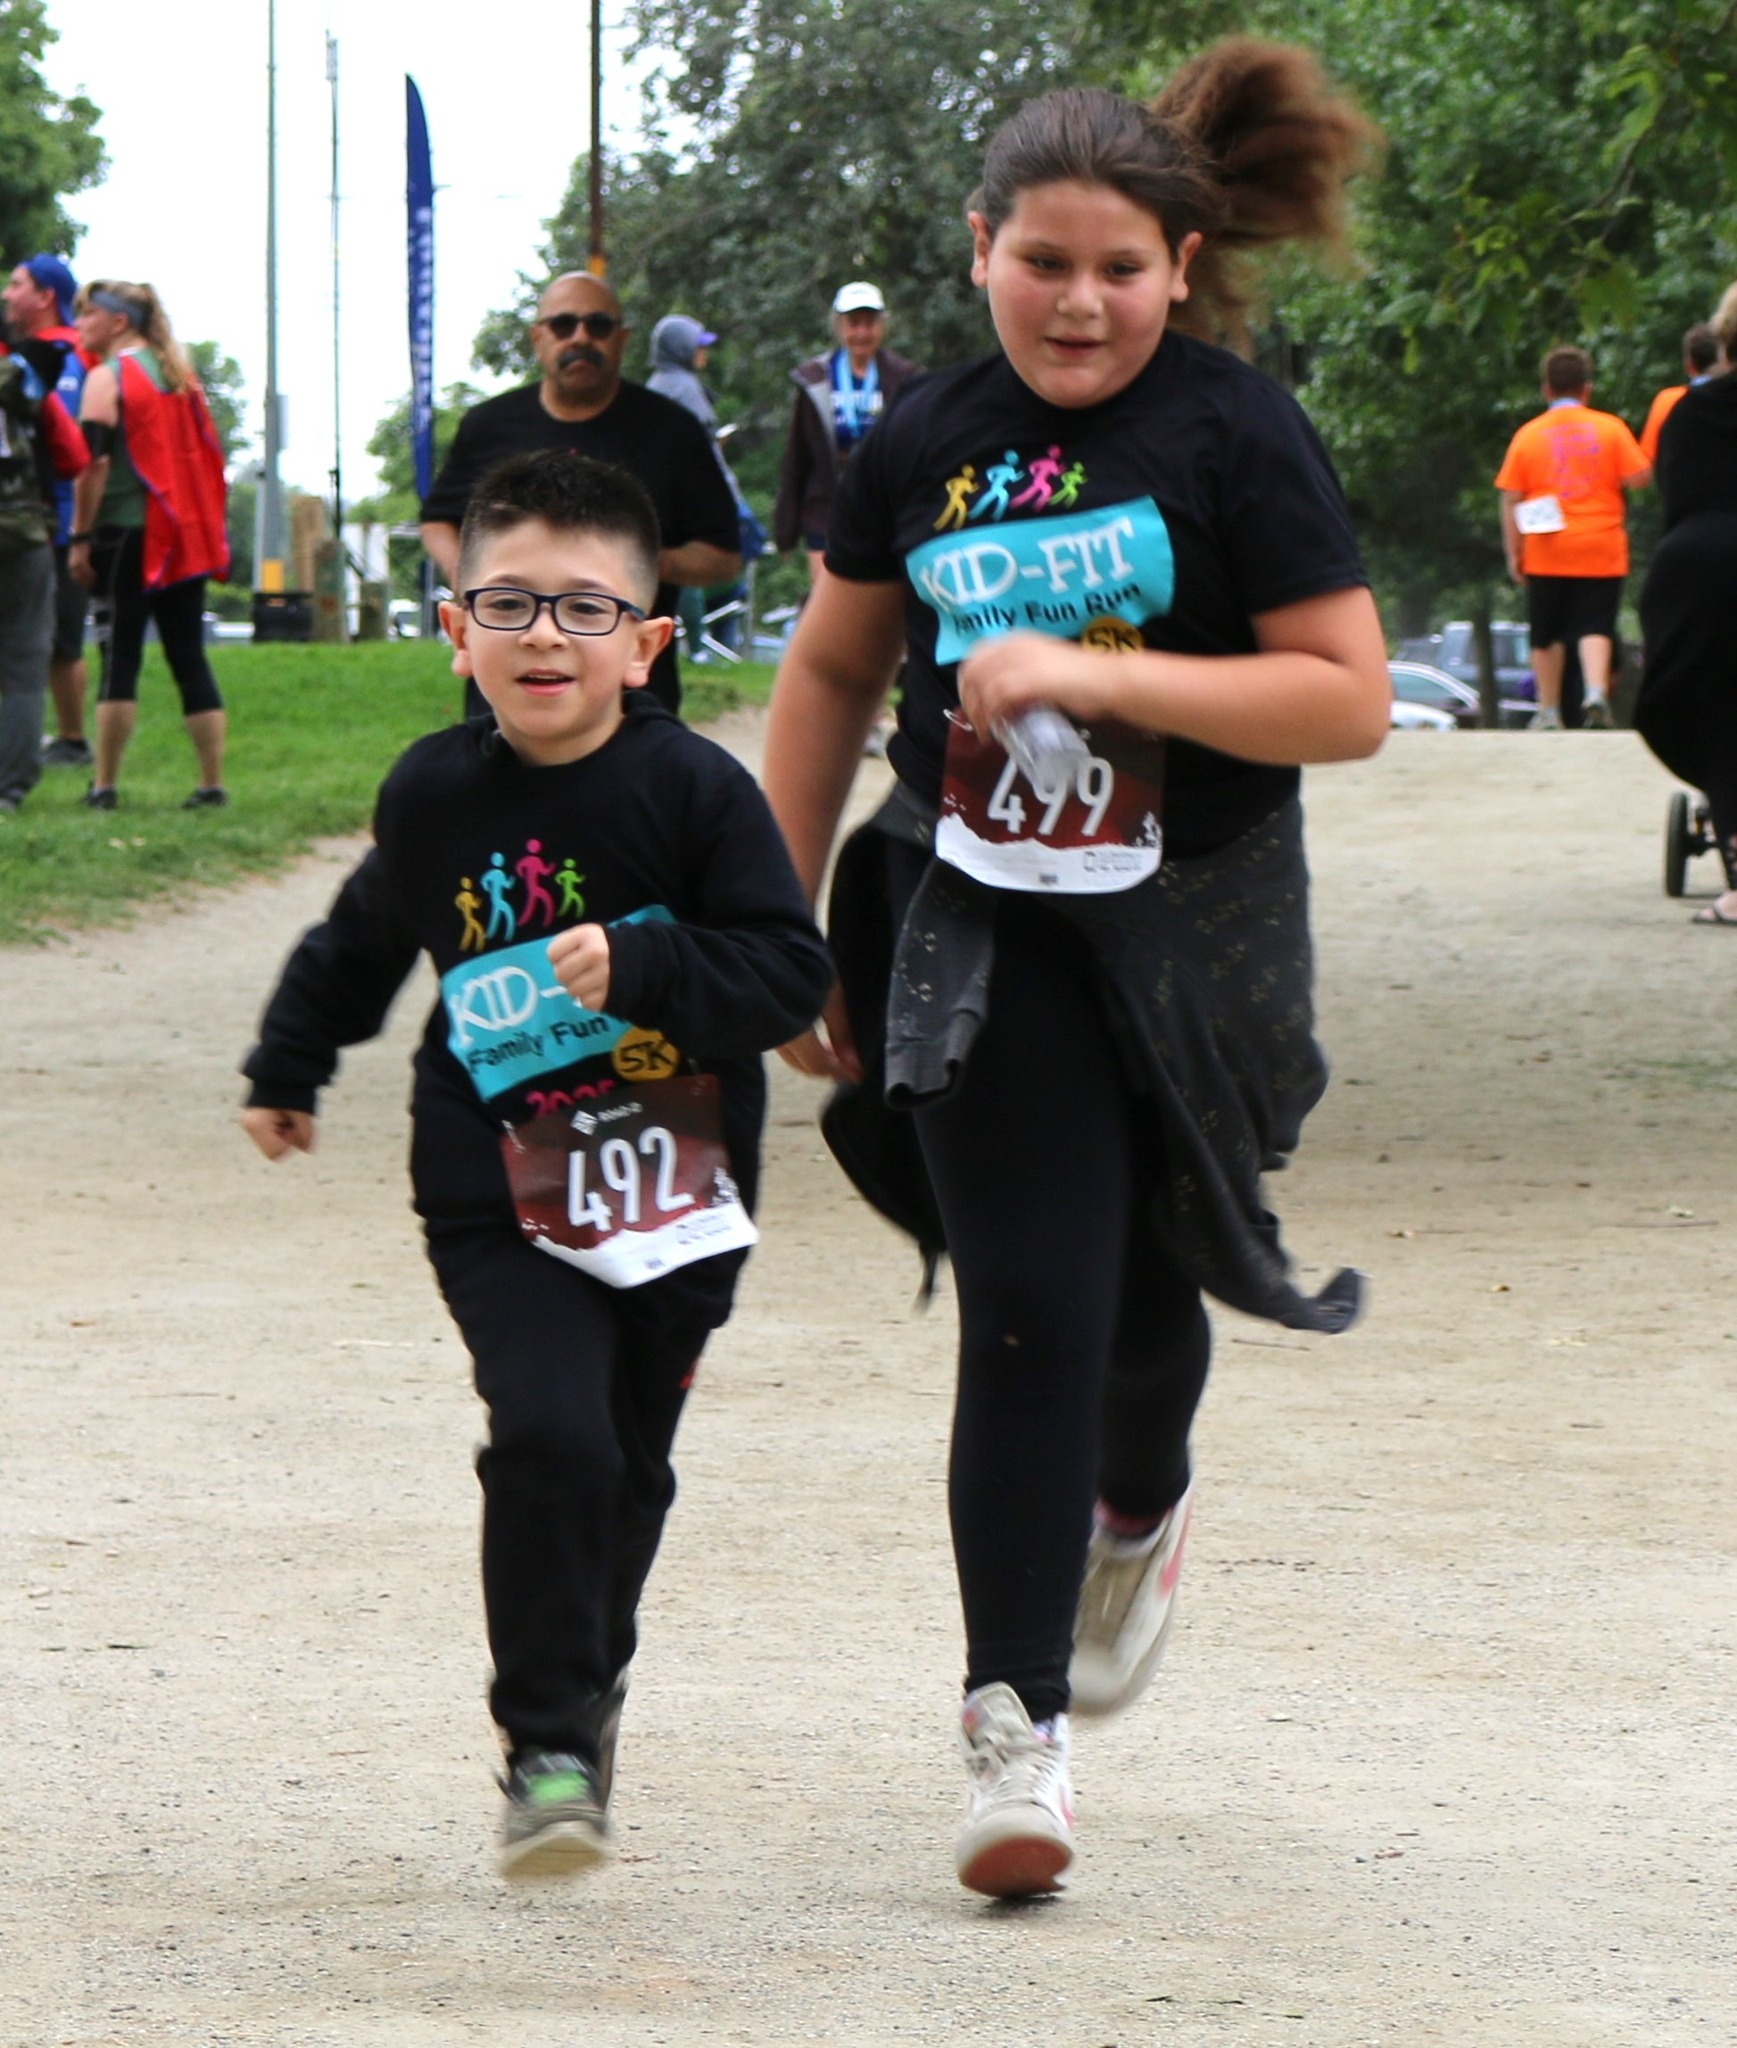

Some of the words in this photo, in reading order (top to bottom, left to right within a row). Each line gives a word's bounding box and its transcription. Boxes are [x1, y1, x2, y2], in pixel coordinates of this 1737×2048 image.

[919, 516, 1135, 612] KID-FIT
[1024, 600, 1079, 624] Fun
[1084, 581, 1142, 617] Run
[986, 756, 1115, 838] 499
[448, 965, 583, 1048] KID-
[467, 1031, 545, 1075] Family
[550, 1016, 611, 1047] Fun
[619, 1038, 675, 1074] 5K
[567, 1125, 696, 1233] 492
